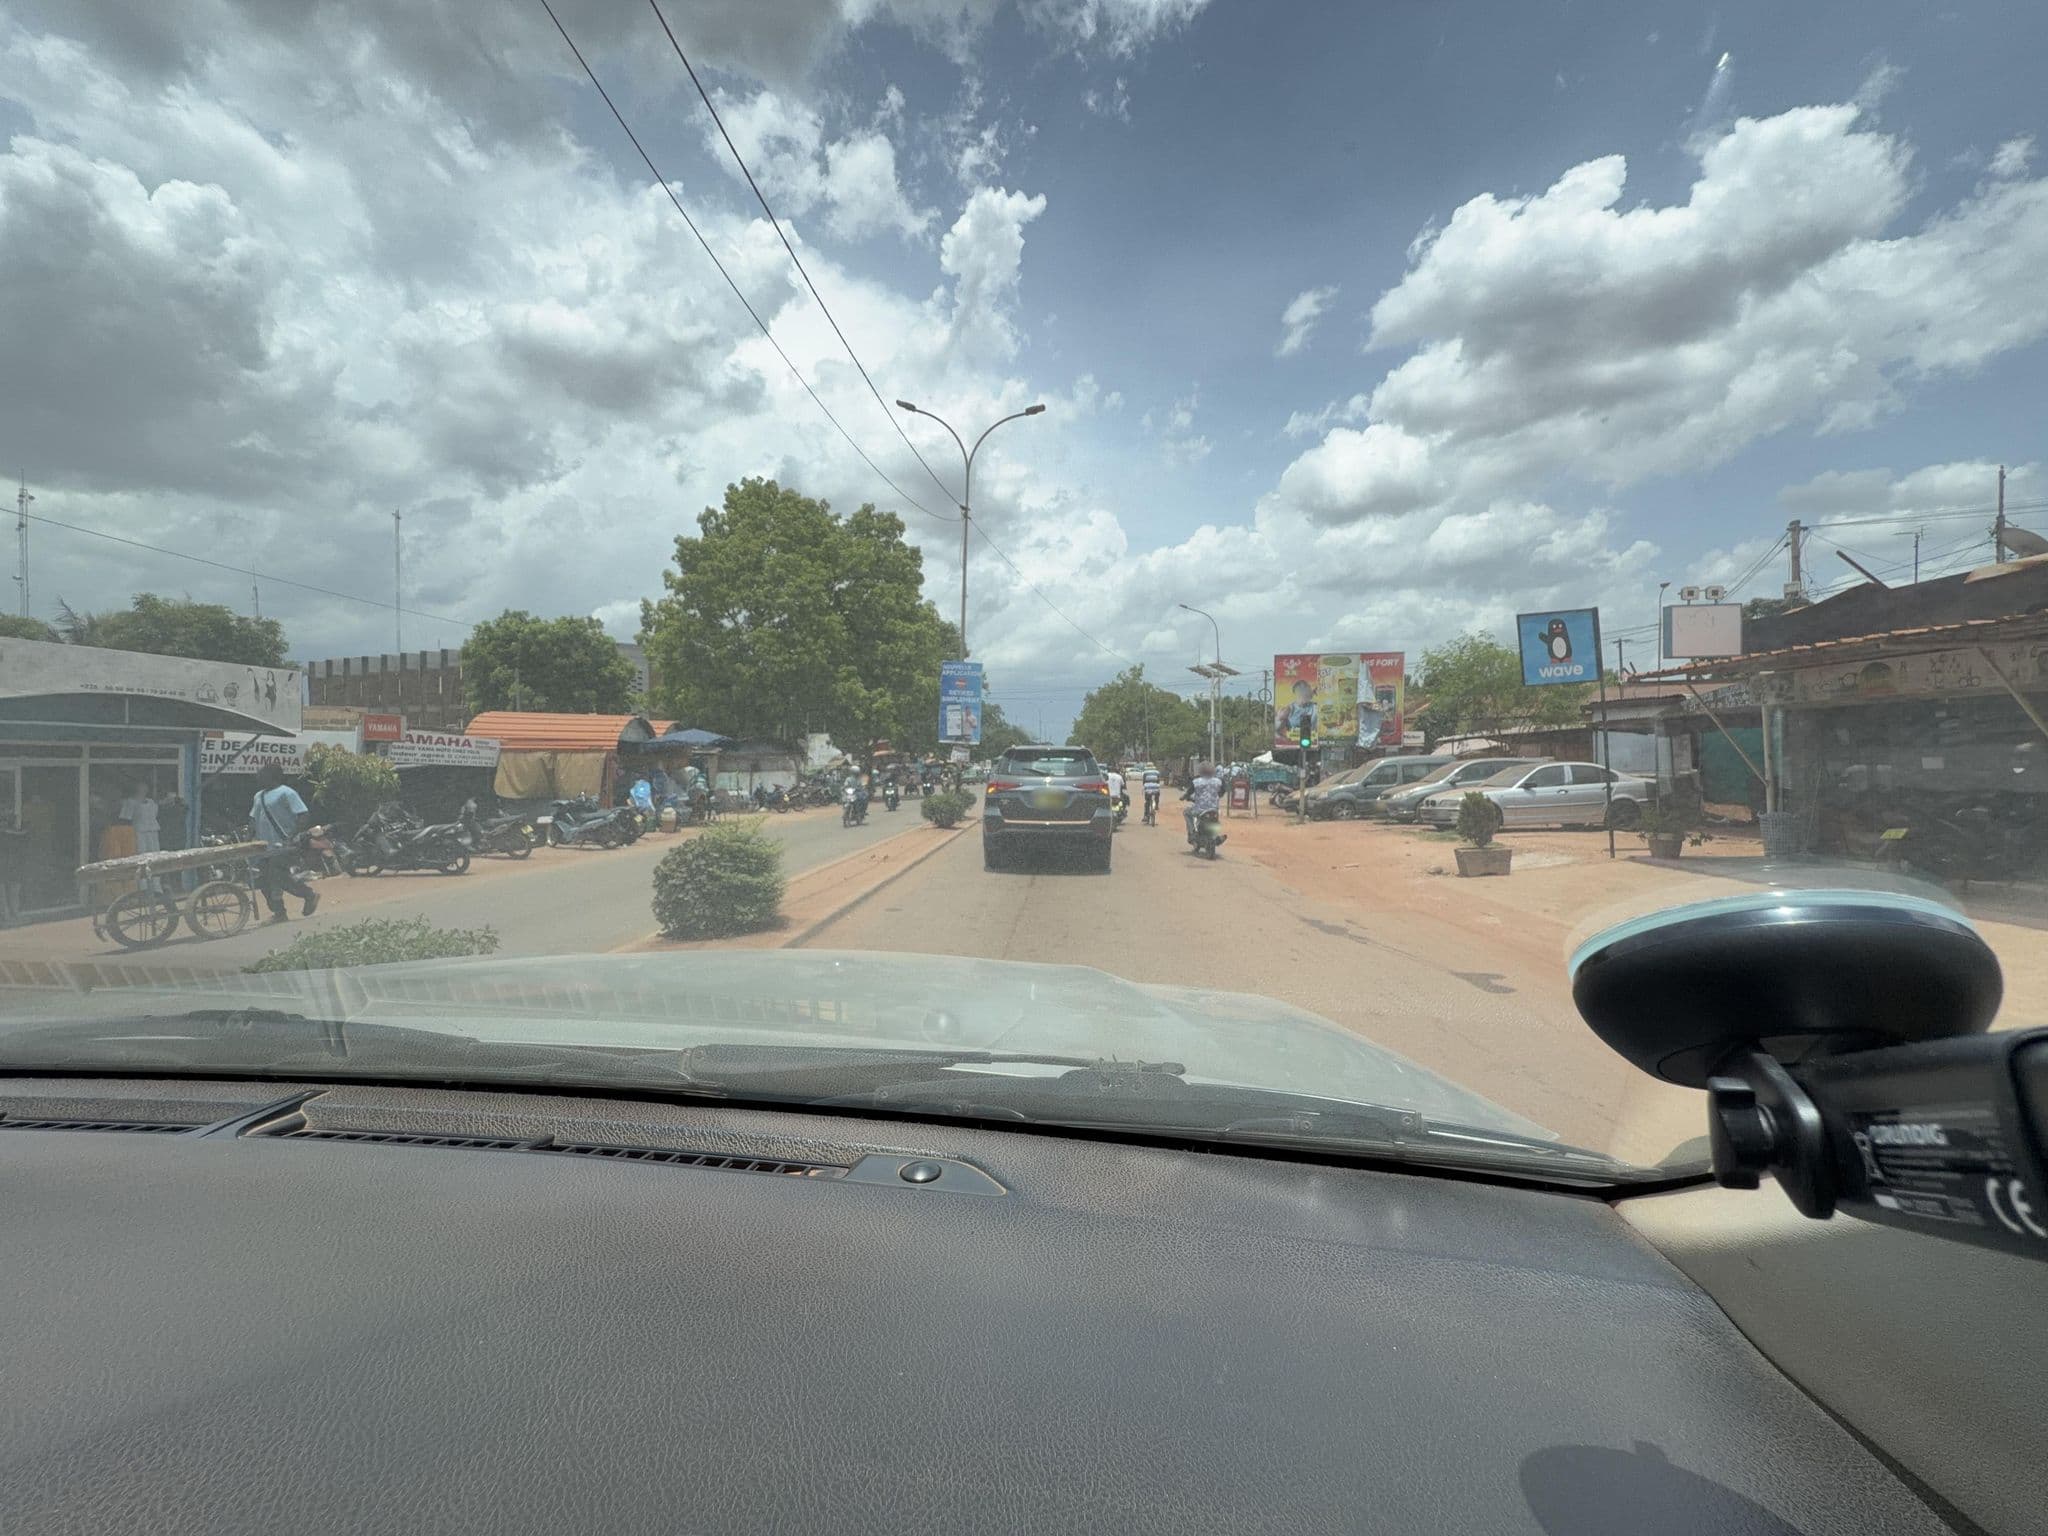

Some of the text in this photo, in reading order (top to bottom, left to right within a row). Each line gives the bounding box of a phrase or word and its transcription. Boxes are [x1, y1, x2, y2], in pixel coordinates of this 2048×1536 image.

[1538, 664, 1584, 679] wave
[368, 723, 398, 733] YAMAHA
[221, 740, 241, 751] DE
[245, 742, 297, 755] PIECES
[405, 733, 473, 748] AMAHA
[242, 755, 300, 767] YAMAHA
